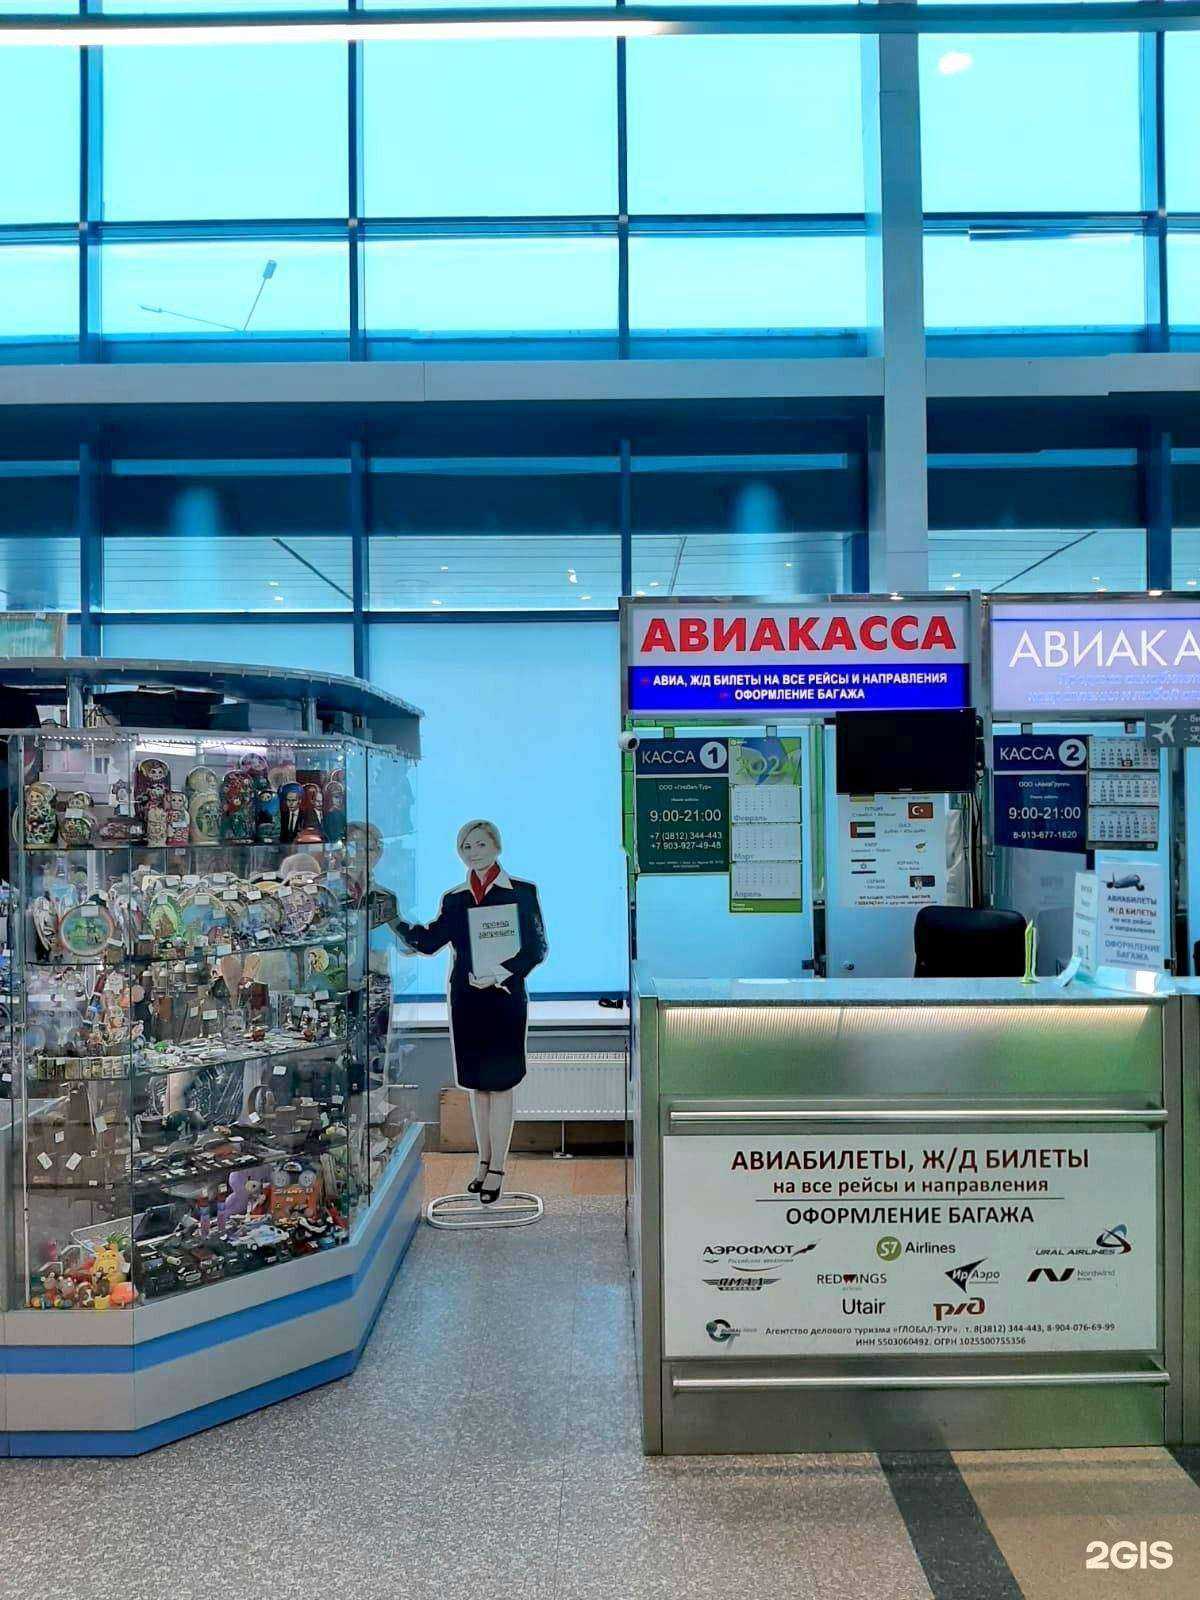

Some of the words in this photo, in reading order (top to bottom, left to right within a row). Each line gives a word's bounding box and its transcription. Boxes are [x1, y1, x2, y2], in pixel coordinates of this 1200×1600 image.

[640, 616, 957, 652] АВИАКАССА
[653, 675, 688, 688] АВИА,
[690, 675, 711, 687] Ж/Д
[713, 674, 761, 686] БИЛЕТЫ
[764, 674, 779, 686] НА
[783, 674, 805, 686] ВСЕ
[808, 673, 849, 685] РЕЙСЫ
[852, 673, 860, 685] И
[863, 672, 948, 685] НАПРАВЛЕНИЯ
[734, 689, 816, 701] ОФОРМЛЕНИЕ
[818, 688, 866, 701] БАГАЖА
[641, 750, 697, 763] КАССА
[707, 746, 719, 764] 1
[1000, 747, 1055, 760] КАССА
[1066, 744, 1080, 761] 2
[650, 809, 721, 823] 9:00-21:00
[1008, 806, 1081, 820] 9:00-21:00
[650, 832, 660, 840] +7
[662, 831, 688, 841] (3812)
[690, 831, 722, 840] 344-443
[651, 842, 661, 850] +7
[733, 853, 754, 861] Март
[1107, 895, 1157, 905] АВИАБИЛЕТЫ
[1108, 906, 1125, 915] Ж/Д
[1126, 908, 1157, 918] БИЛЕТЫ
[1104, 940, 1160, 953] ОФОРМЛЕНИЕ
[1115, 950, 1149, 961] БАГАЖА
[731, 1150, 914, 1172] АВИАБИЛЕТЫ,
[922, 1150, 978, 1172] Ж/Д
[985, 1149, 1089, 1170] БИЛЕТЫ
[773, 1181, 795, 1193] на
[802, 1181, 832, 1193] все
[838, 1177, 898, 1196] рейсы
[904, 1181, 915, 1192] и
[921, 1179, 1049, 1196] направления
[786, 1207, 942, 1224] ОФОРМЛЕНИЕ
[949, 1206, 1034, 1224] БАГАЖА
[703, 1245, 795, 1255] АЭРОФЛОТ
[880, 1241, 898, 1257] S7
[905, 1241, 956, 1254] Airlines
[842, 1298, 886, 1315] Utair
[765, 1327, 809, 1335] Агентство
[854, 1328, 891, 1336] туризма
[974, 1325, 1006, 1334] 8(3812)
[1008, 1325, 1044, 1334] 344-443,
[856, 1338, 876, 1346] ИНН
[934, 1337, 957, 1345] ОГРН
